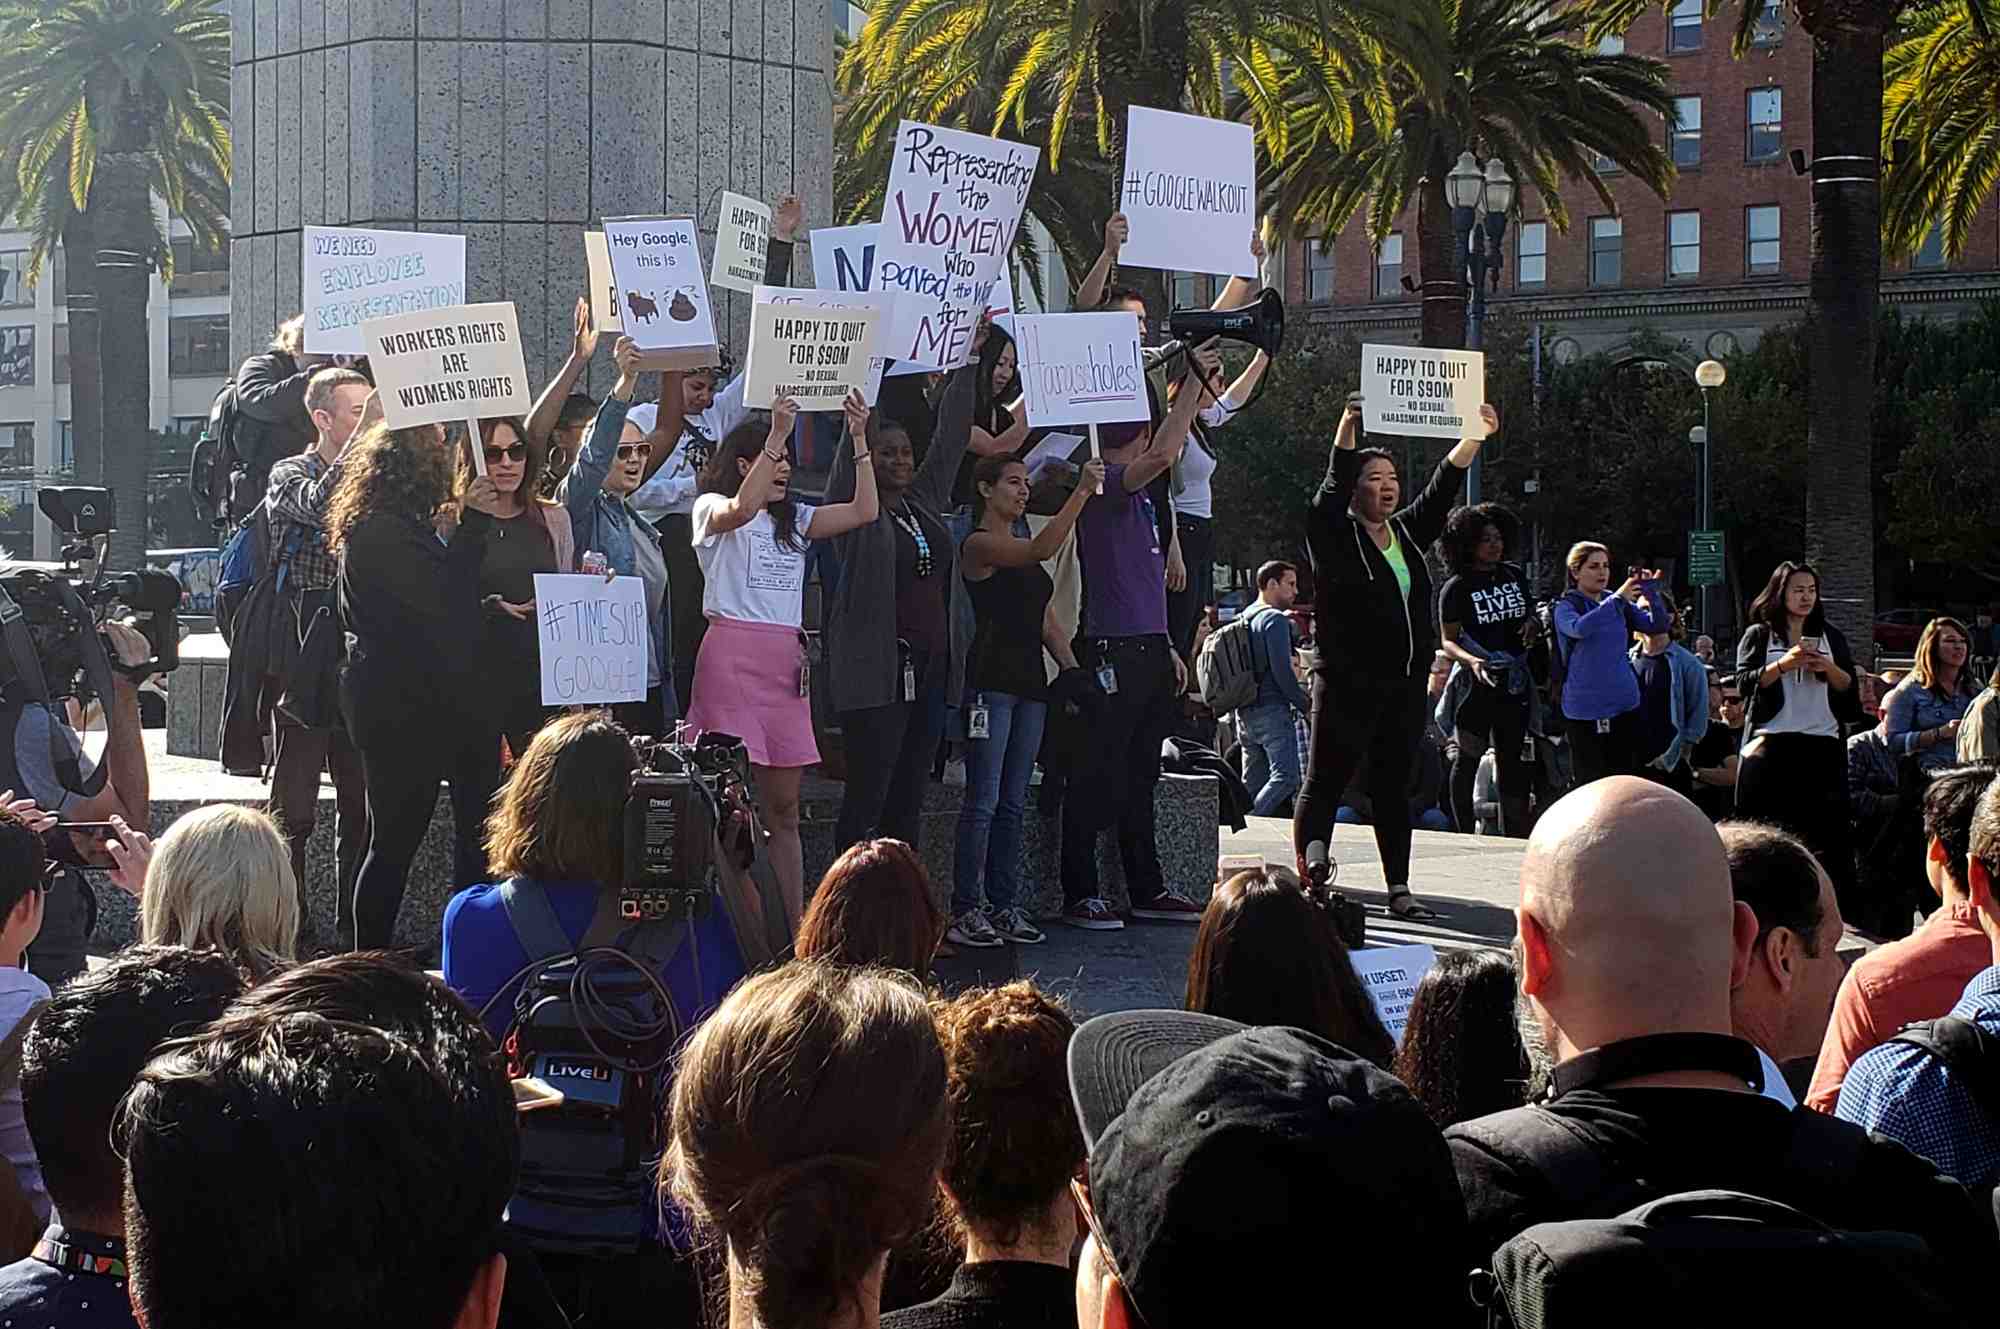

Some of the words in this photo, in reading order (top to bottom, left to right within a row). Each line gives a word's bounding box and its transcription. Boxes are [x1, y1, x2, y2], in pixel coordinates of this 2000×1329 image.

[904, 128, 1033, 204] Representing
[956, 180, 990, 211] the
[1126, 169, 1247, 214] #GOOGLEWALKOUT
[732, 207, 759, 231] HAPPY
[896, 190, 1014, 256] WOMEN
[313, 236, 340, 255] WE
[341, 236, 377, 256] NEED
[612, 232, 638, 249] Hey
[642, 231, 691, 248] Google,
[740, 231, 756, 251] FOR
[637, 254, 661, 267] this
[664, 253, 676, 266] is
[320, 252, 425, 314] EMPLOYEE
[313, 281, 464, 331] REPRESENTATION
[936, 301, 968, 327] for
[380, 326, 456, 356] WORKERS
[457, 322, 506, 345] RIGHTS
[774, 318, 821, 341] HAPPY
[824, 321, 838, 341] TO
[840, 321, 866, 343] QUIT
[909, 316, 970, 367] ME
[442, 353, 469, 374] ARE
[789, 344, 814, 364] FOR
[817, 343, 850, 366] $90M
[805, 370, 815, 381] NO
[816, 370, 839, 381] SEXUAL
[1377, 357, 1417, 376] HAPPY
[1420, 360, 1435, 377] TO
[1439, 361, 1467, 379] QUIT
[398, 380, 466, 408] WOMENS
[468, 376, 513, 400] RIGHTS
[1390, 379, 1413, 396] FOR
[1408, 401, 1417, 411] NO
[1419, 402, 1445, 412] SEXUAL
[1381, 412, 1428, 425] HARASSMENT
[1429, 415, 1463, 427] REQUIRED
[1471, 581, 1520, 601] BLACK
[1474, 592, 1526, 614] LIVES
[1477, 606, 1526, 624] MATTER
[1370, 969, 1408, 985] UPSET!
